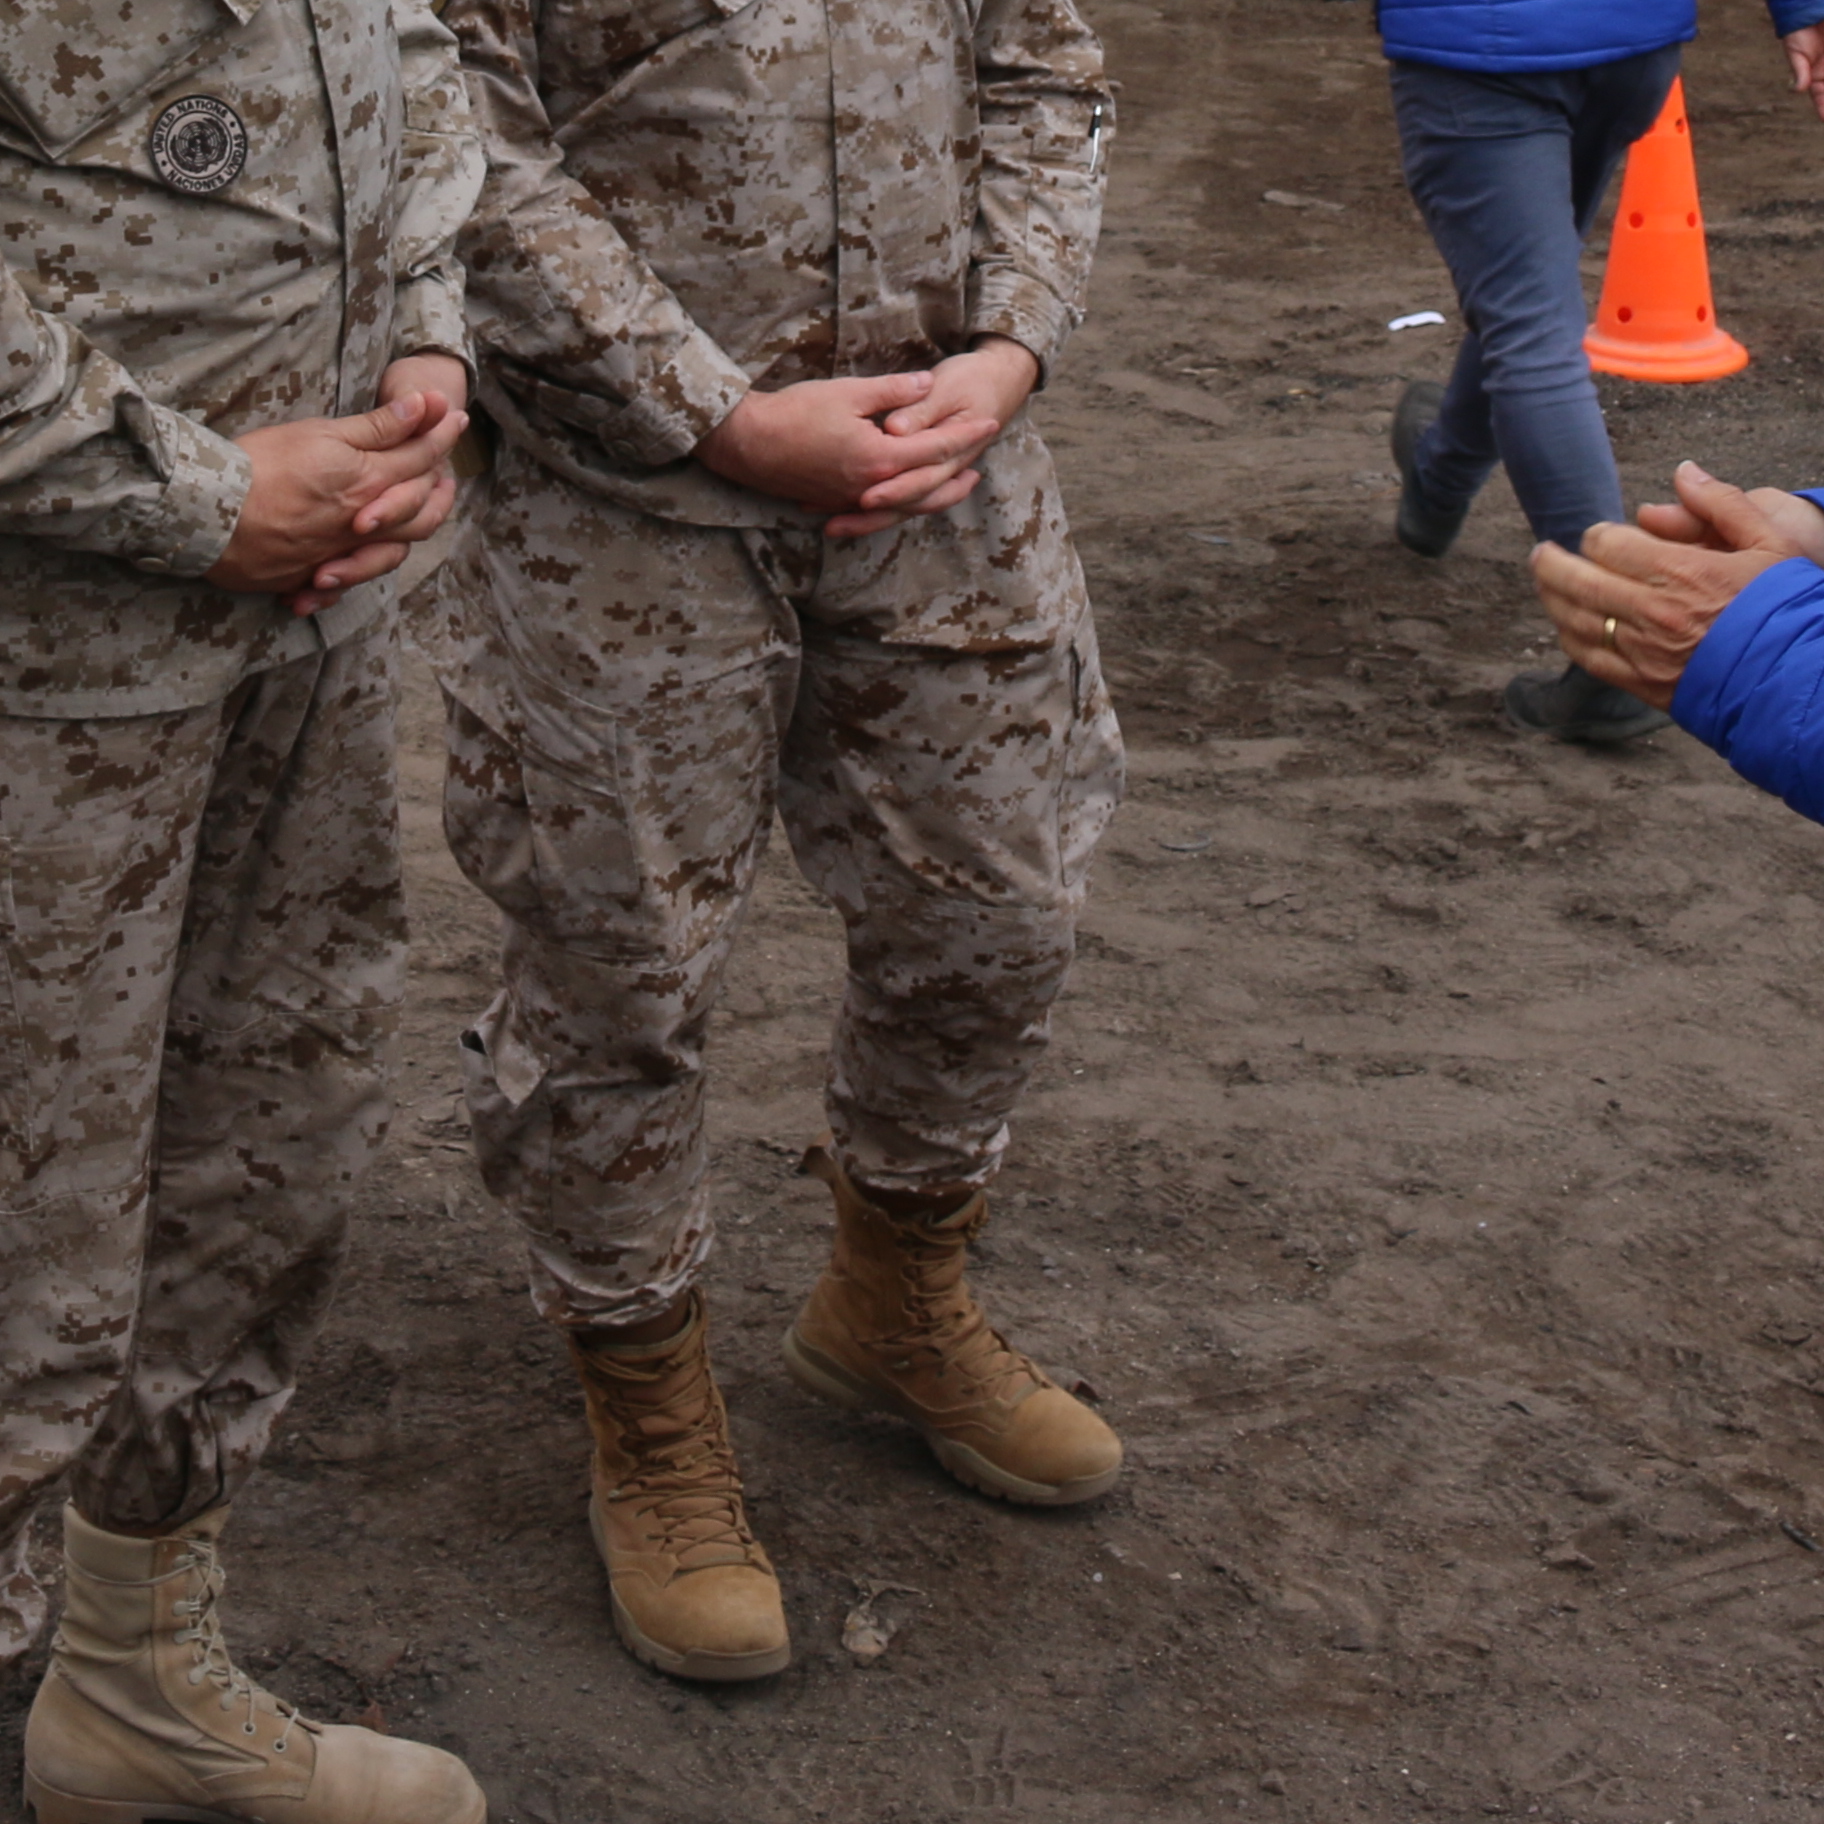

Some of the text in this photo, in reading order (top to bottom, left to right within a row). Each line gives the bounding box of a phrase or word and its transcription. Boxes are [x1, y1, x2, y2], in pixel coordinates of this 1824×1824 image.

[153, 100, 229, 154] UNITED NATIONS
[167, 169, 225, 190] NACIONES
